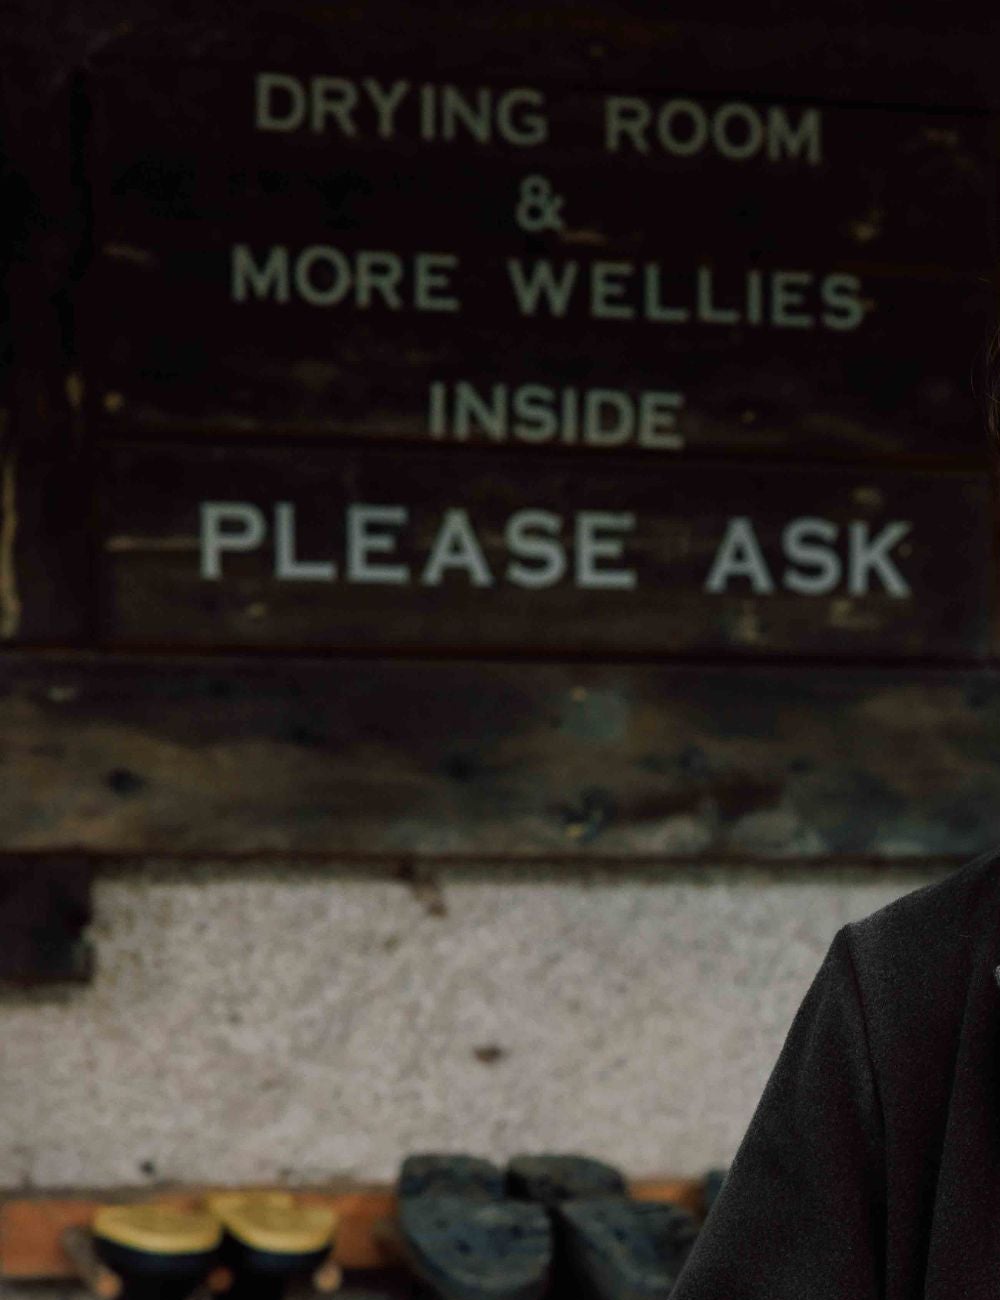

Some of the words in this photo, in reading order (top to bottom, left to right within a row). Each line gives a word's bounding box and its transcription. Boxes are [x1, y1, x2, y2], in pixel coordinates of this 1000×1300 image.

[254, 72, 548, 146] DRYING
[605, 97, 823, 166] ROOM
[516, 175, 565, 232] &
[231, 245, 460, 312] MORE
[508, 259, 866, 331] WELLIES
[428, 382, 685, 450] INSIDE
[200, 503, 637, 590] PLEASE
[704, 517, 912, 598] ASK
